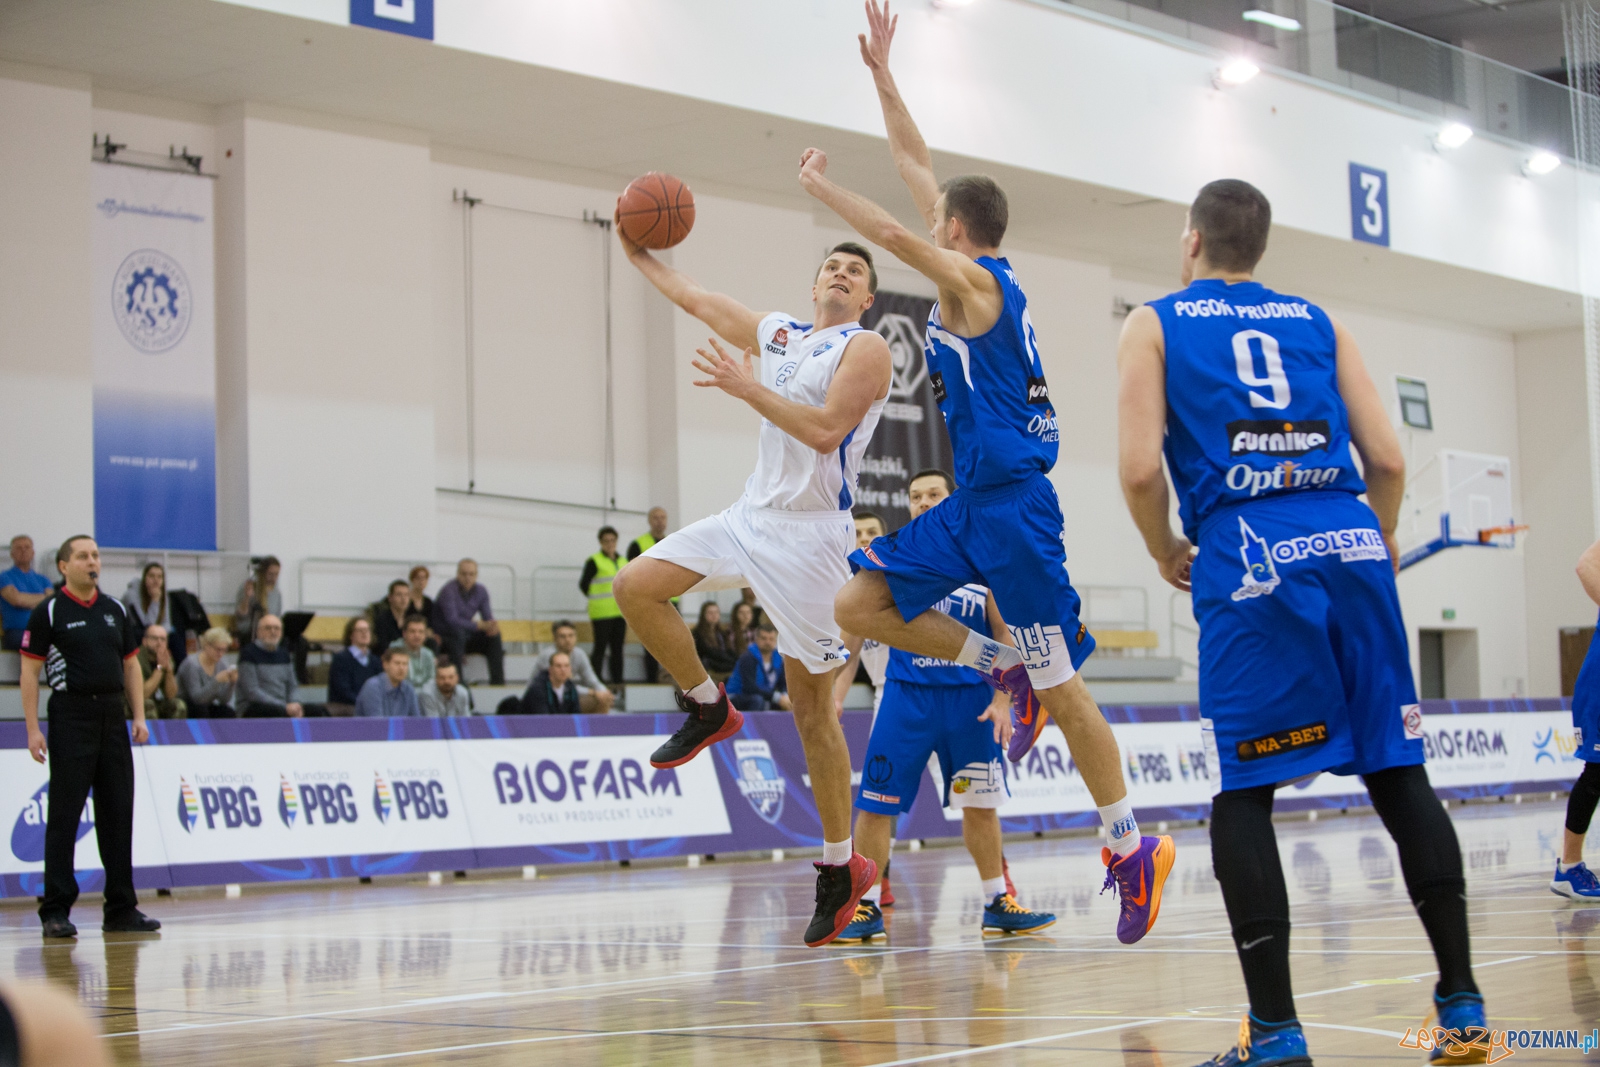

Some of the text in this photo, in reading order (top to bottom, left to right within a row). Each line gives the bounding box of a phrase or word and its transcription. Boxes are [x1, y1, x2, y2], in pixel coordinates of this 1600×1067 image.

[1361, 171, 1383, 238] 3
[1174, 298, 1313, 319] POGOŃ PRUDNIK
[1231, 329, 1291, 410] 9
[1276, 531, 1382, 560] OPOLSKIE
[1014, 622, 1050, 661] 14
[1255, 724, 1327, 753] WA-BET
[1423, 729, 1508, 759] BIOFARM
[493, 758, 682, 804] BIOFARM
[1138, 752, 1172, 783] PBG
[199, 786, 262, 829] PBG
[298, 783, 358, 825] PBG
[392, 780, 449, 821] PBG
[518, 804, 674, 825] POLSKI PRODUCENT LEKÓW
